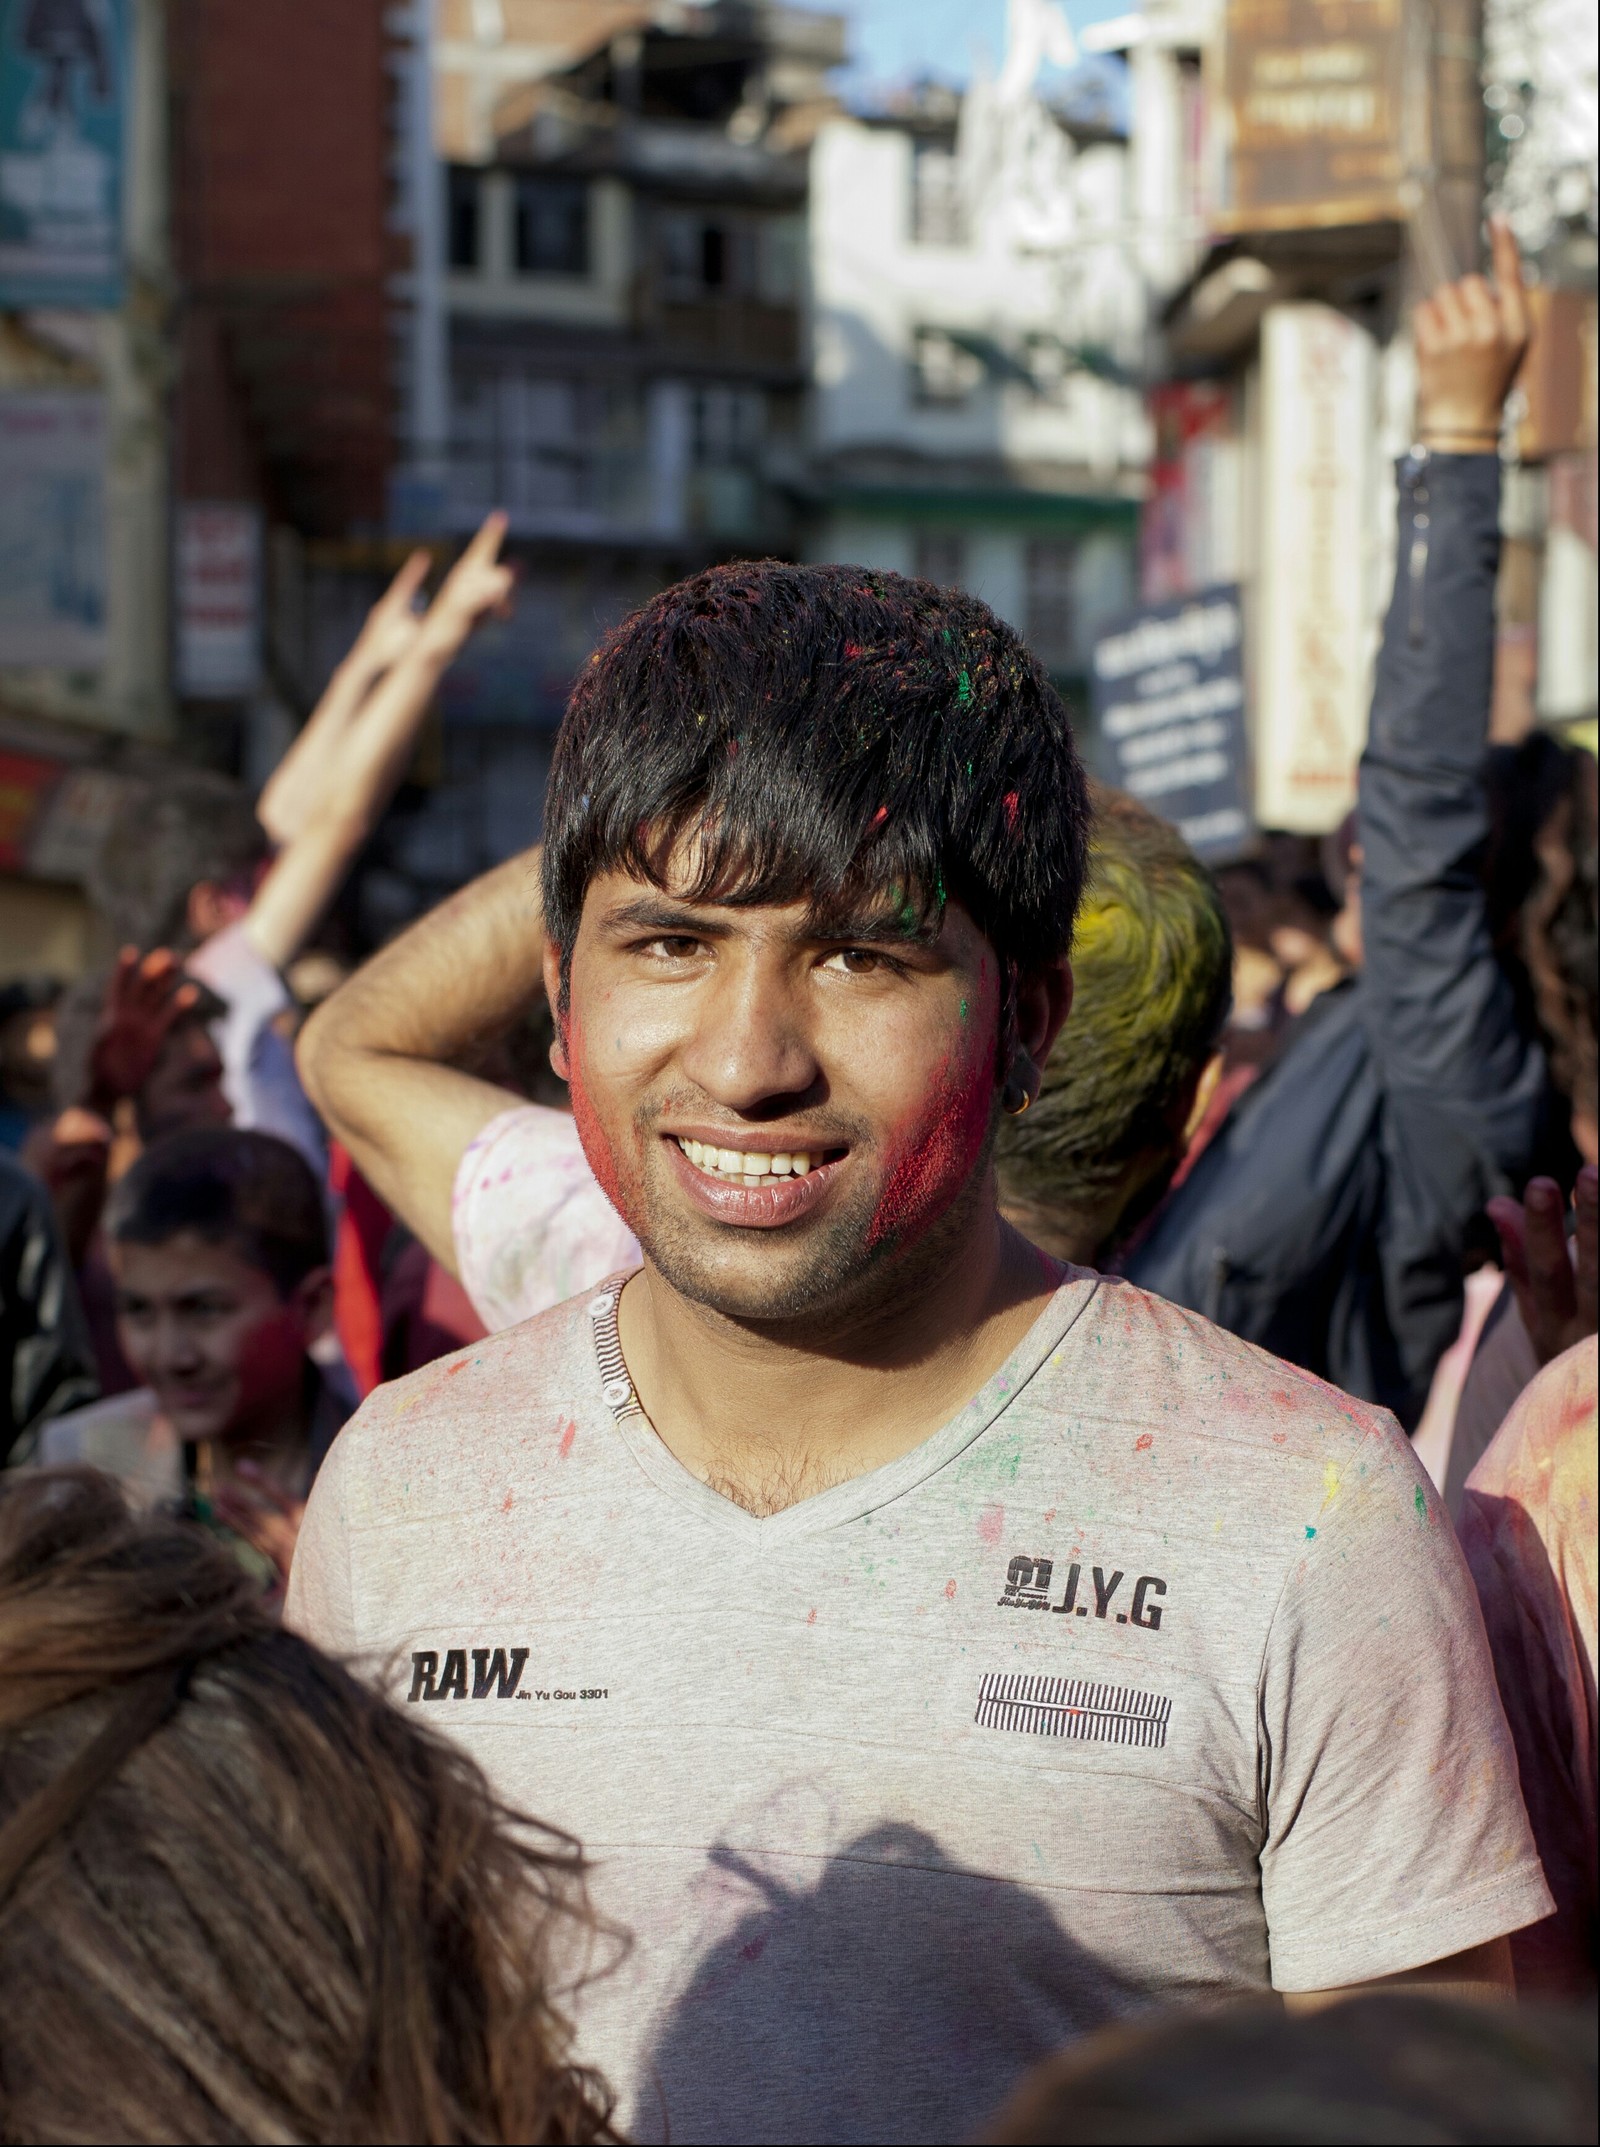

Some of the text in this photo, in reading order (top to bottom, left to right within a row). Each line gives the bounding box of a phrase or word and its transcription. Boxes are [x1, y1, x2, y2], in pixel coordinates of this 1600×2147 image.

[1052, 1563, 1167, 1631] J.Y.G
[407, 1648, 530, 1703] RAW
[515, 1689, 609, 1700] Jin Yu Gou 3301
